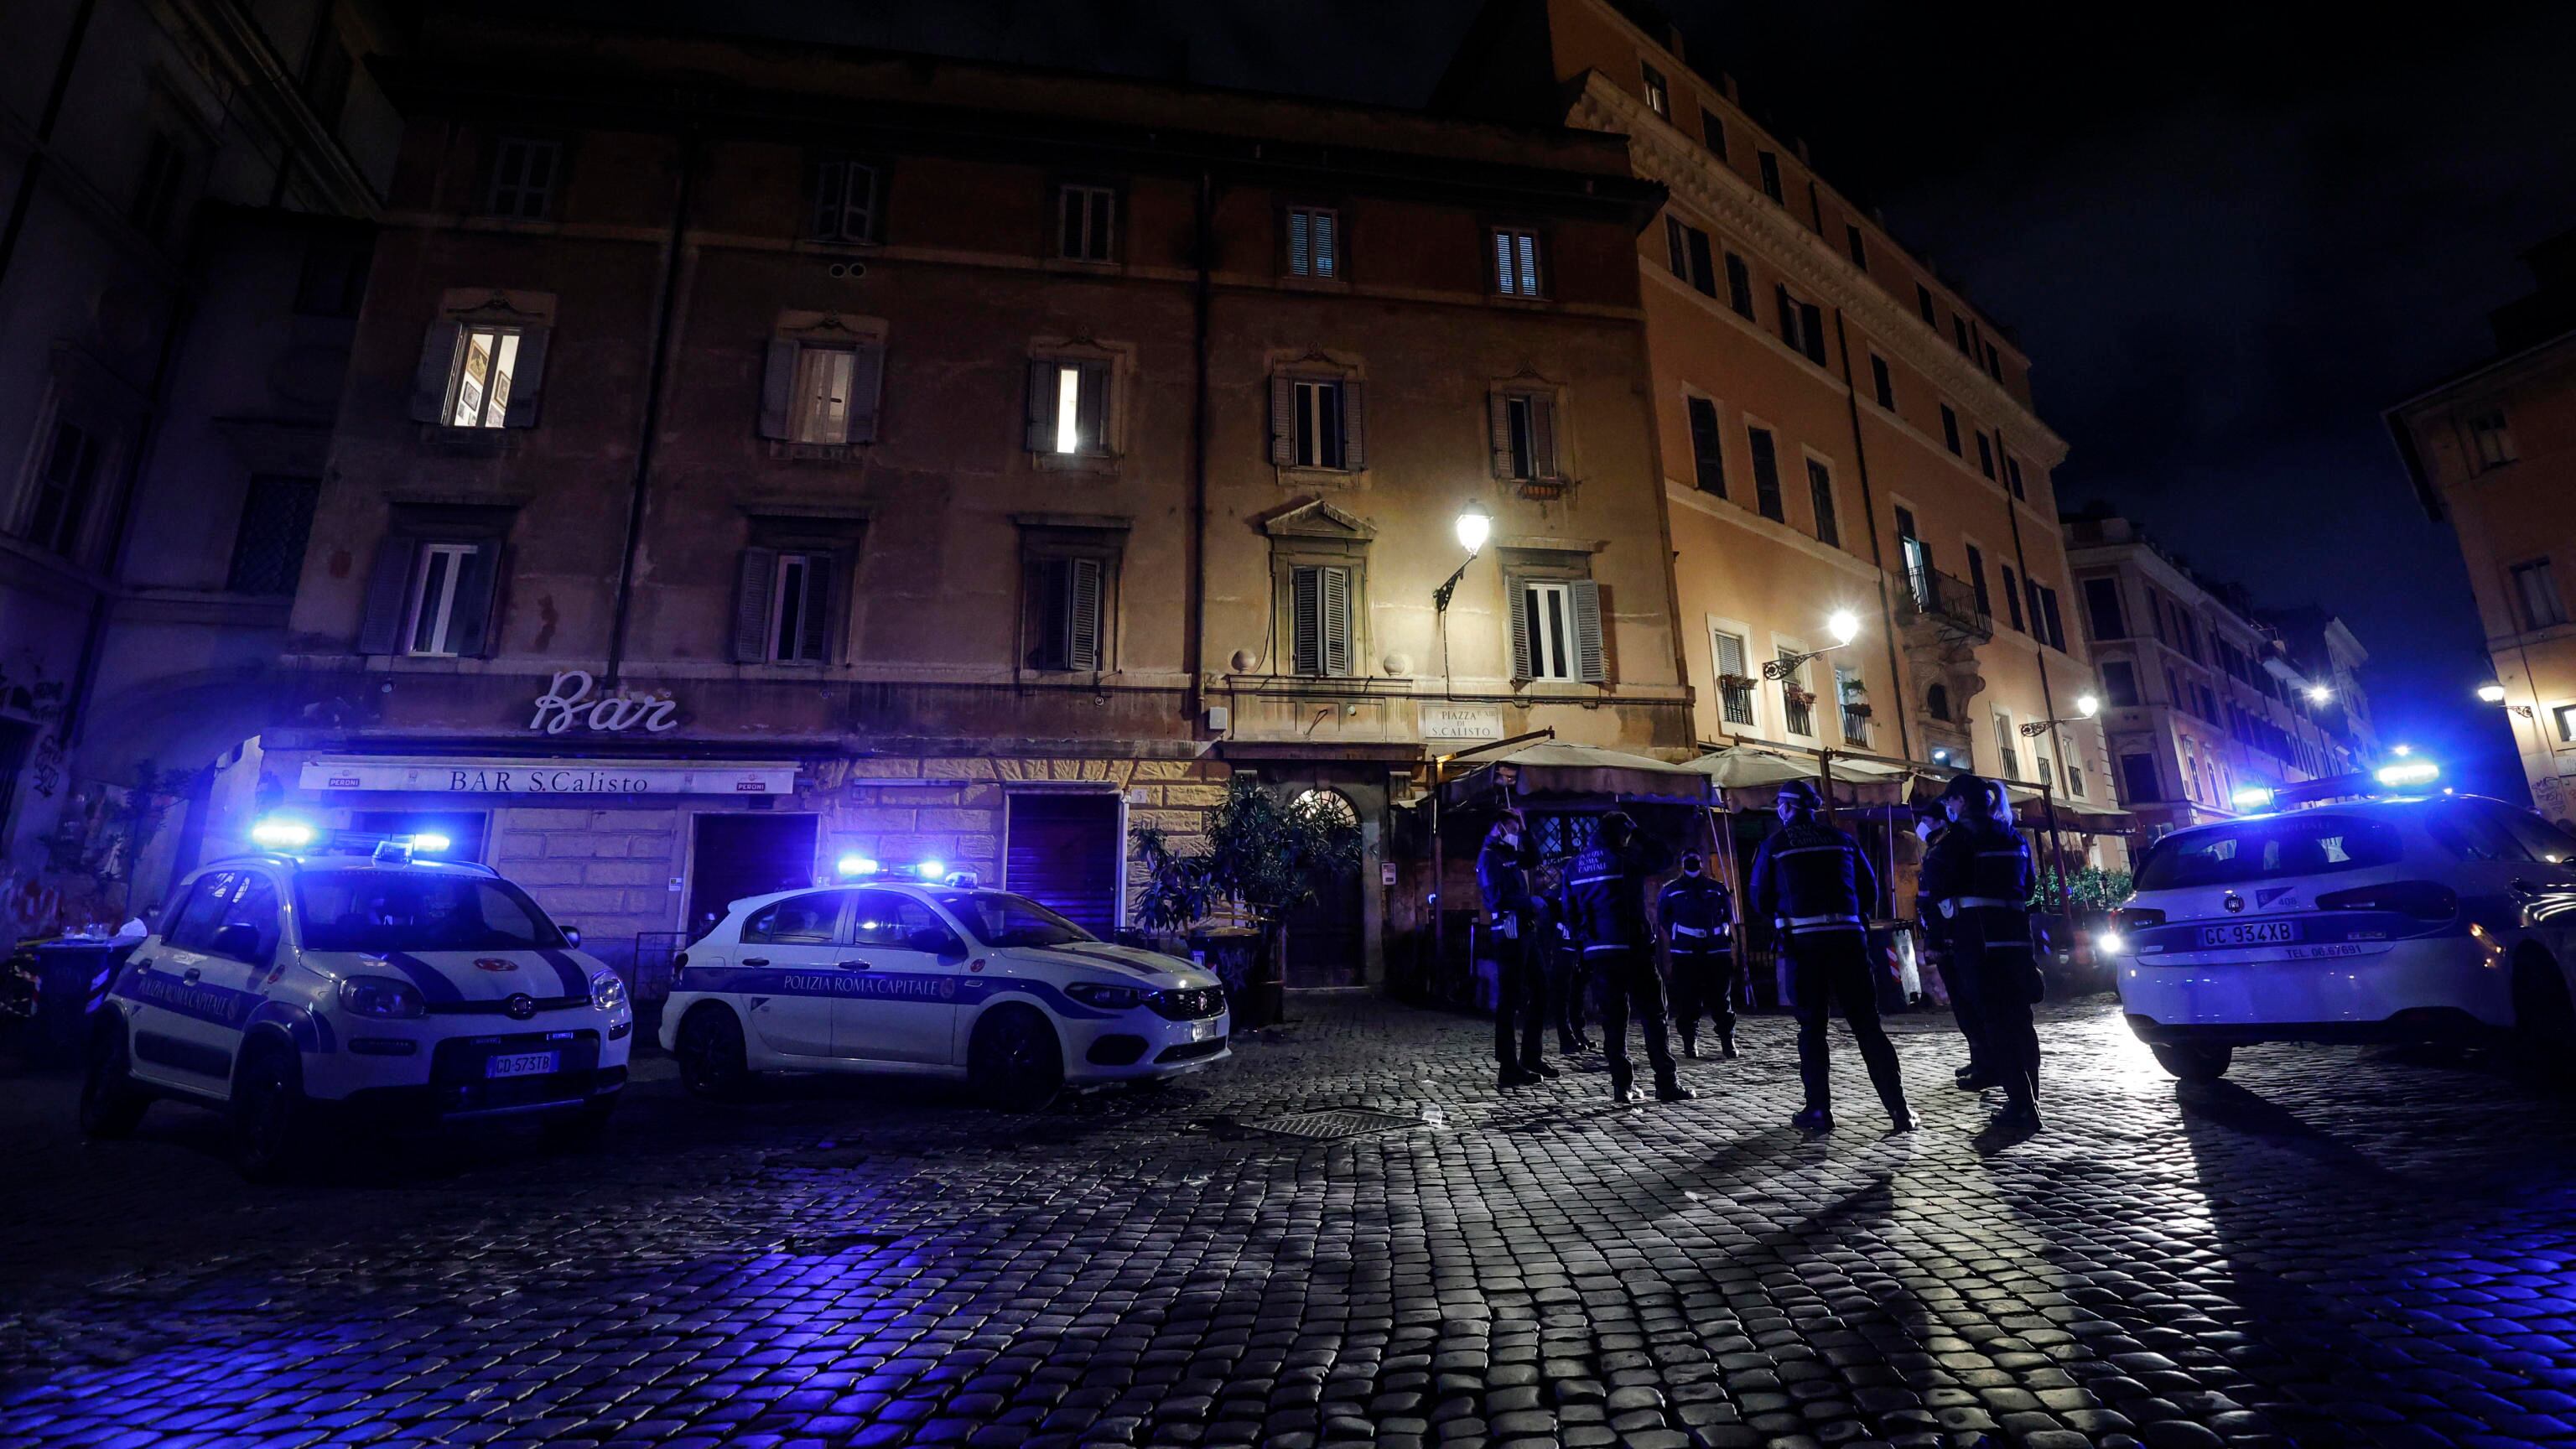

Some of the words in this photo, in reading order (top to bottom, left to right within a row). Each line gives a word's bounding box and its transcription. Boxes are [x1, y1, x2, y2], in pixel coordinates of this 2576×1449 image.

[529, 670, 678, 735] Bar
[1441, 711, 1477, 720] PIAZZA
[1431, 727, 1490, 736] S.CALISTO
[330, 778, 358, 787] PERONI
[449, 770, 512, 792] BAR
[2205, 927, 2226, 944] GC
[2233, 922, 2291, 943] 934XB
[2286, 948, 2309, 958] TEL.
[784, 975, 830, 990] POLIZIA
[834, 977, 874, 993] ROMA
[877, 979, 938, 995] CAPITALE
[515, 1056, 550, 1072] 573TB
